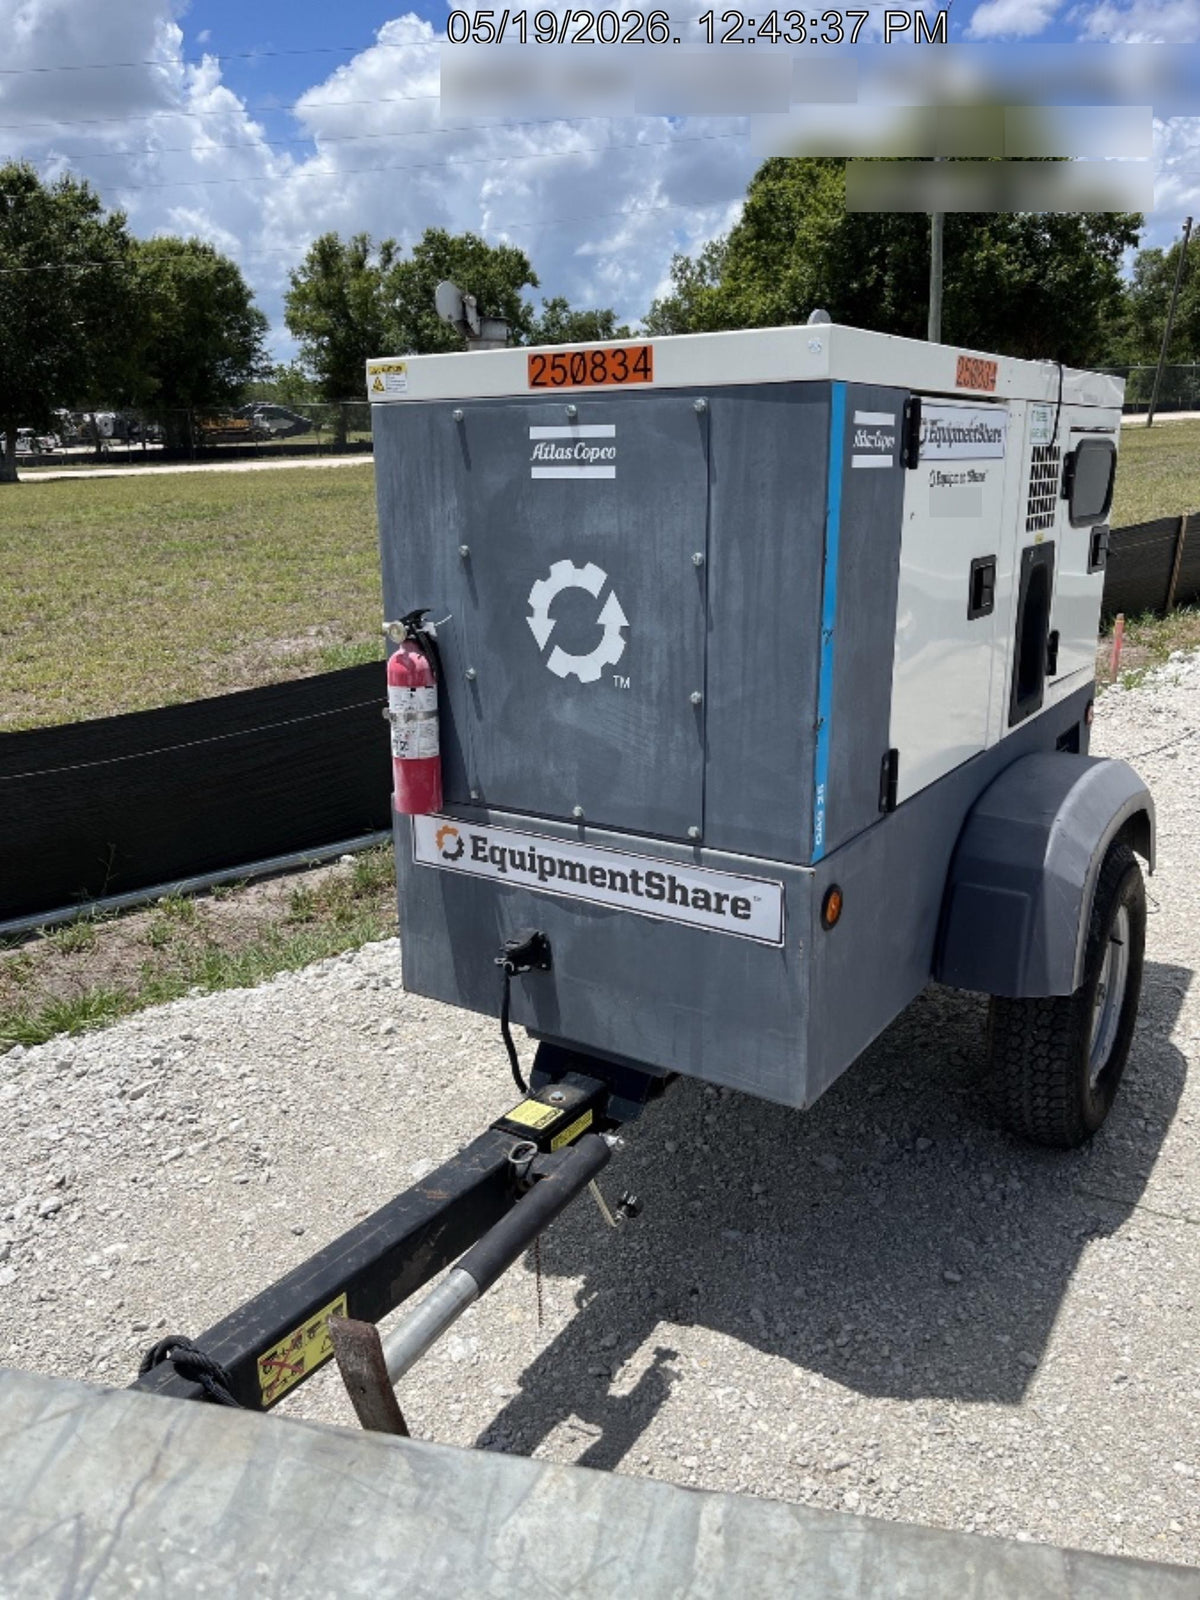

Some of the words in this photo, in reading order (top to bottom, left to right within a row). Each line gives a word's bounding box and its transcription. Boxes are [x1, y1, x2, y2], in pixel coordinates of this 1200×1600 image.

[531, 346, 651, 386] 250834
[613, 675, 630, 688] TM
[470, 833, 752, 920] EquipmentShare
